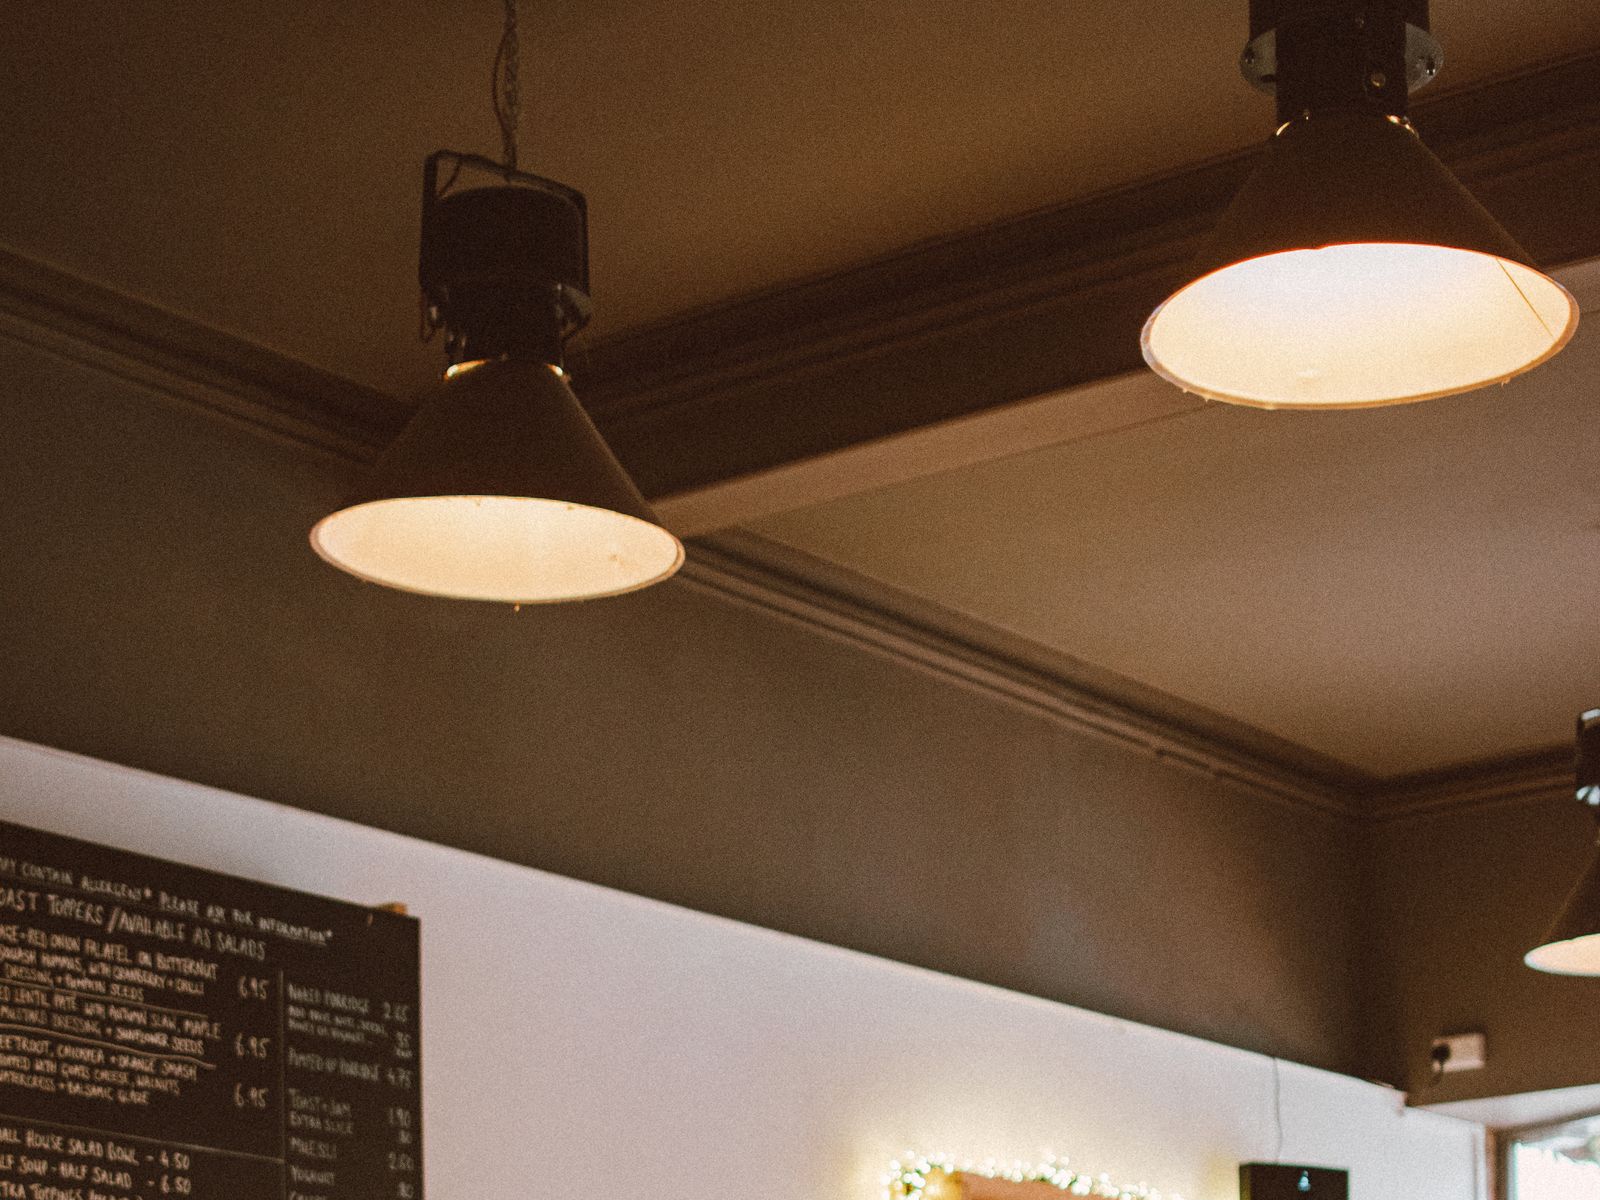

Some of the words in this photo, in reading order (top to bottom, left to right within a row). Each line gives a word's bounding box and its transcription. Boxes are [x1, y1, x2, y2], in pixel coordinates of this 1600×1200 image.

[47, 893, 104, 926] TOPPERS
[193, 928, 212, 950] AS
[216, 931, 267, 961] SALADS
[110, 983, 144, 1003] SEEDS
[170, 1036, 204, 1057] SEEDS
[234, 1031, 271, 1059] 6.95
[234, 1081, 270, 1109] 6.95
[289, 1110, 321, 1130] EXTRA
[26, 1128, 64, 1152] HOUSE
[67, 1138, 104, 1158] SALAD
[290, 1136, 337, 1159] MUESLI
[18, 1155, 49, 1177] SOUP
[59, 1161, 89, 1181] HALF
[91, 1165, 132, 1190] SALAD
